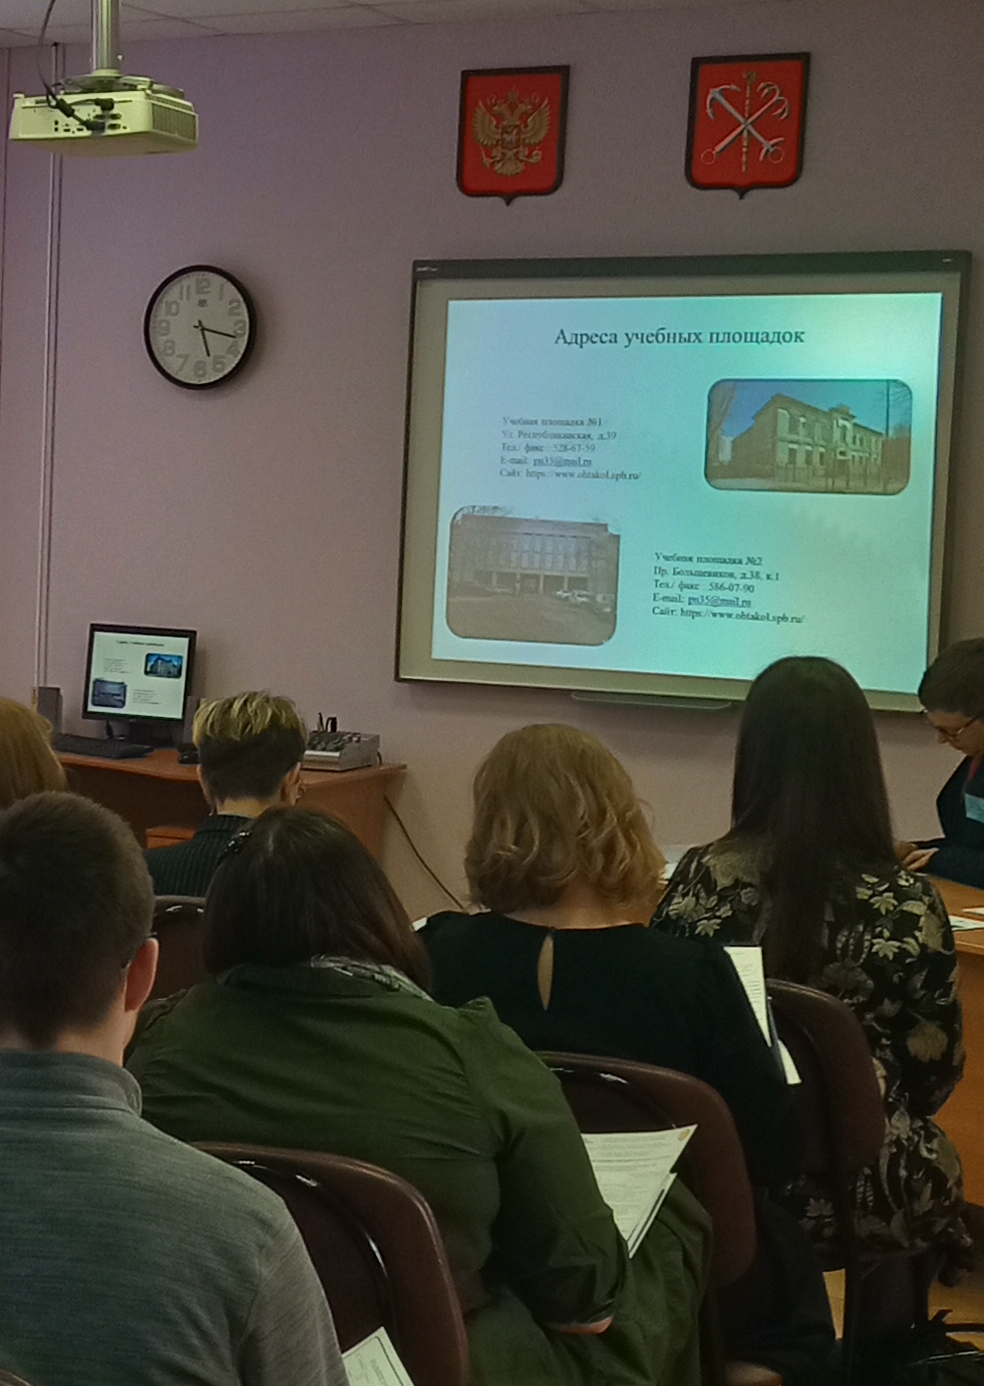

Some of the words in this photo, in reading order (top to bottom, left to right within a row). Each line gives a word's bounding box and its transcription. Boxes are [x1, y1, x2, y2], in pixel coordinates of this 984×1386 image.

[227, 298, 241, 317] 2
[158, 319, 170, 336] 9
[234, 319, 247, 338] 3
[554, 328, 618, 349] Адреса
[624, 327, 703, 349] учебных
[708, 329, 806, 347] площадок
[176, 354, 190, 374] 7
[212, 355, 226, 372] 5
[502, 416, 539, 426] Учебная
[541, 418, 584, 427] площадка
[586, 417, 602, 427] №1
[654, 552, 693, 563] Учебная
[696, 556, 743, 565] площадка
[745, 556, 763, 567] №2
[653, 566, 669, 577] Пр.
[652, 593, 685, 603] E-mail:
